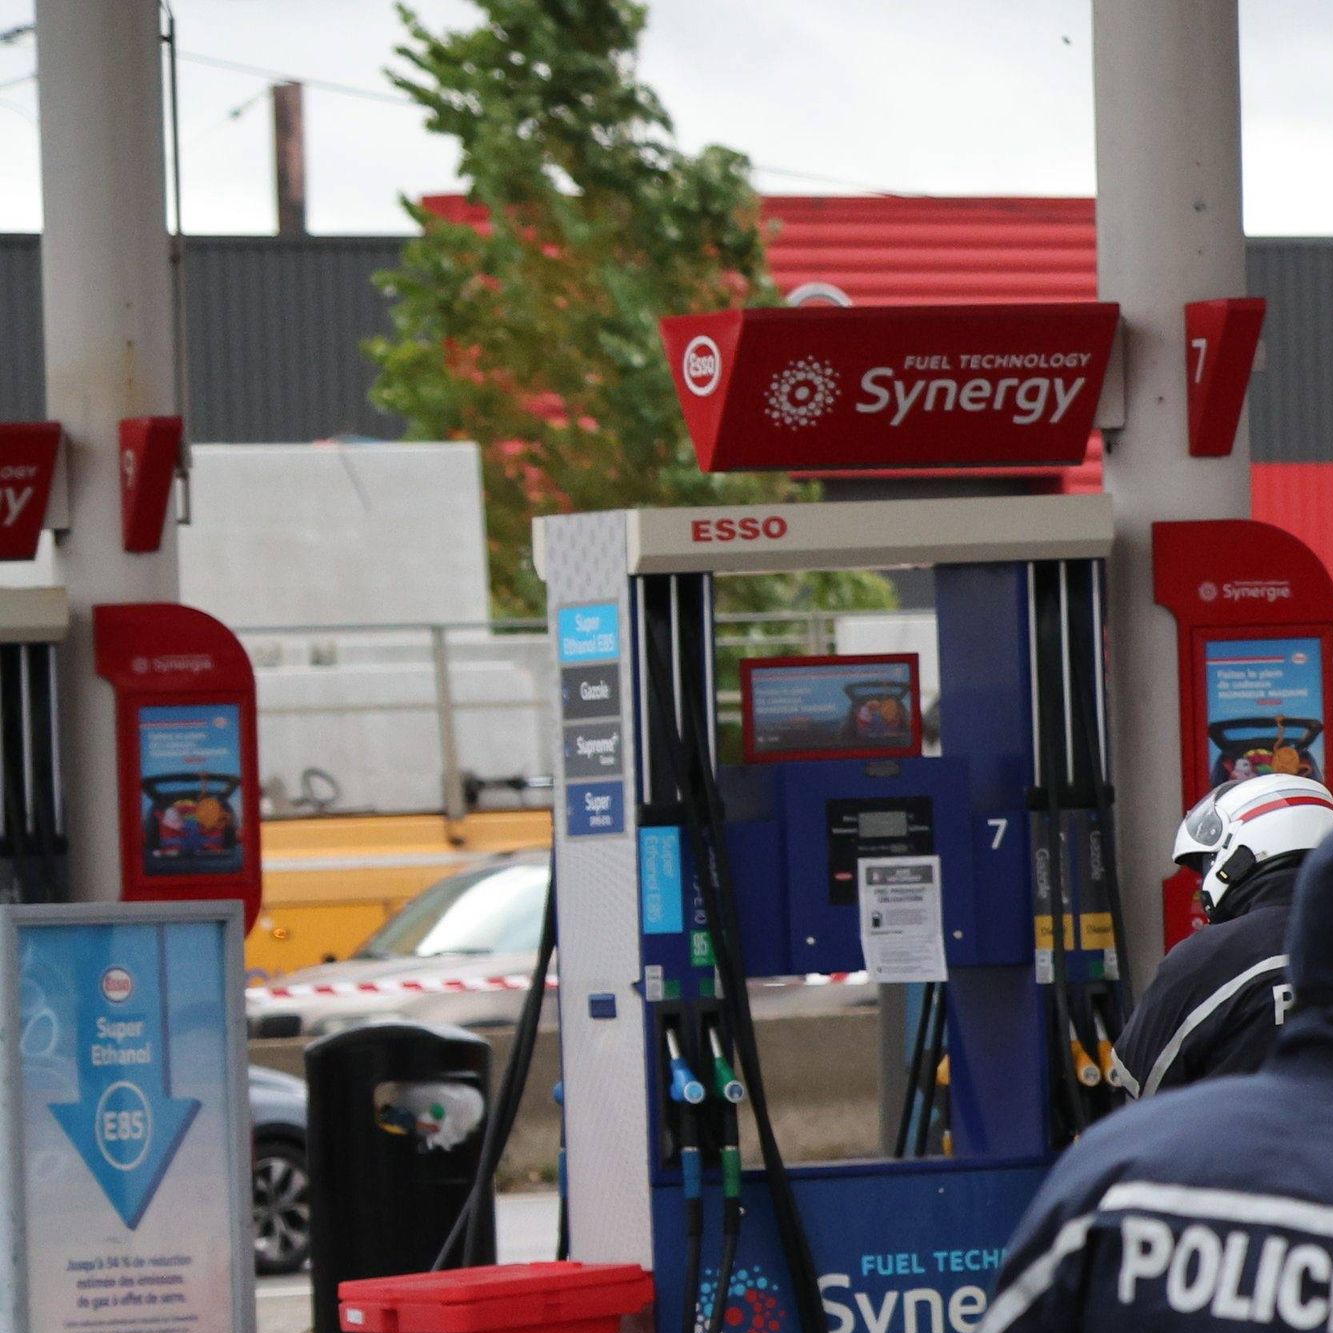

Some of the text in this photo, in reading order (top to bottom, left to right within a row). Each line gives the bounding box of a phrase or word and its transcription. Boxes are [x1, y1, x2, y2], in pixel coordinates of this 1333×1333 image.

[688, 352, 715, 378] Esso
[904, 353, 1091, 370] FUEL TECHNOLOGY
[1191, 338, 1207, 384] 7
[855, 367, 1086, 426] Synergy
[691, 516, 788, 542] ESSO
[1222, 584, 1291, 602] Synergie
[585, 792, 612, 818] Super
[987, 818, 1008, 850] 7
[96, 1016, 144, 1042] Super
[91, 1045, 151, 1066] Ethanol
[102, 1110, 143, 1140] E85
[861, 1253, 925, 1276] FUEL
